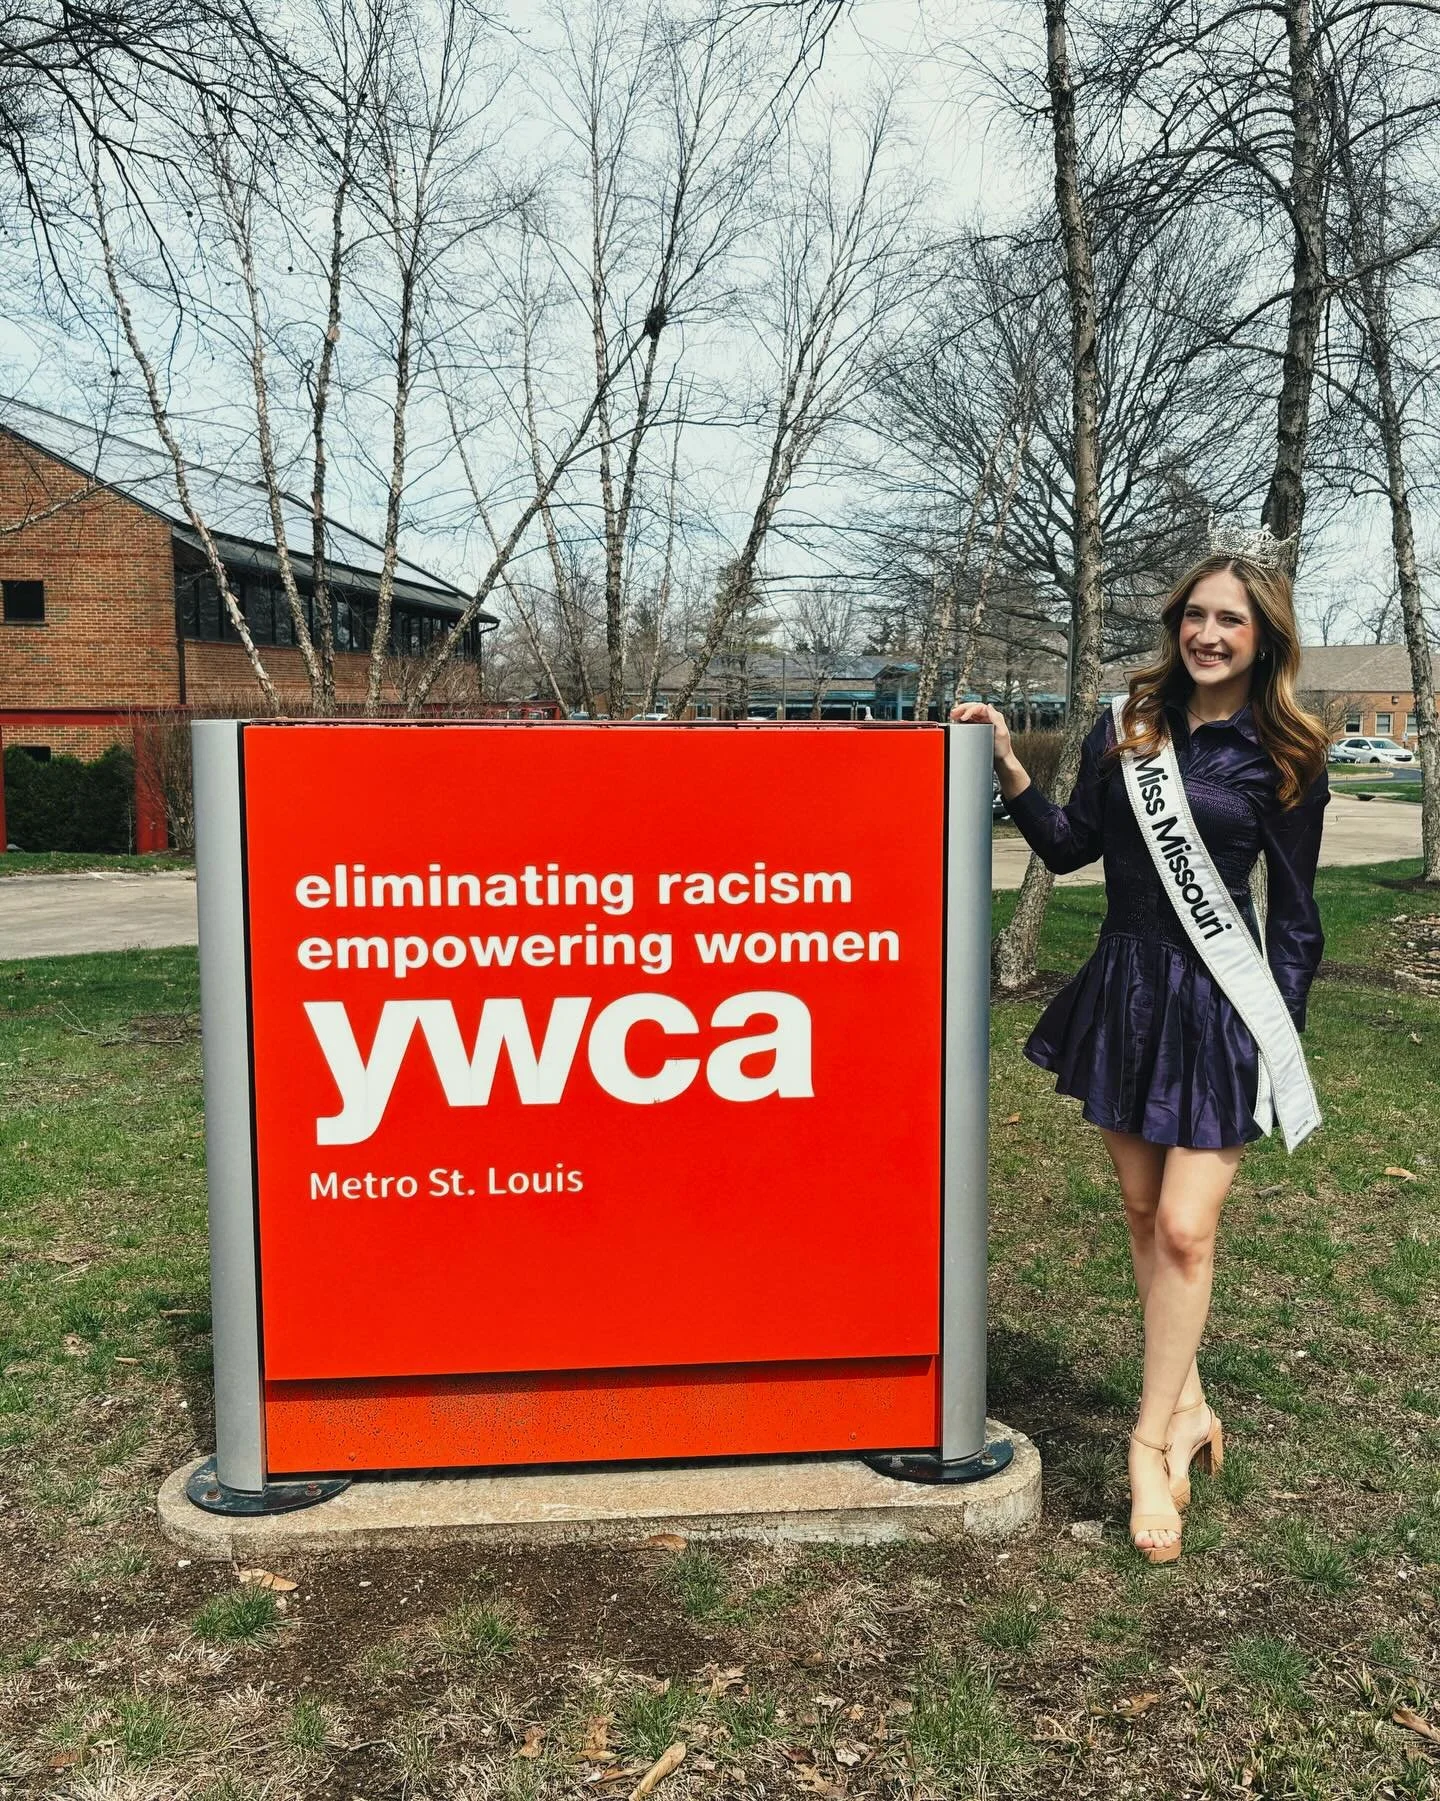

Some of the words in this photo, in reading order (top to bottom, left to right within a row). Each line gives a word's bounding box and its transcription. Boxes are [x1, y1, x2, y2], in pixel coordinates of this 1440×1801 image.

[1132, 751, 1169, 816] Miss
[1151, 815, 1232, 941] Missouri
[296, 863, 634, 915] eliminating
[658, 862, 853, 906] racism
[297, 923, 673, 978] empowering
[694, 930, 900, 964] women
[303, 990, 815, 1146] ywca
[310, 1171, 418, 1200] Metro
[428, 1168, 476, 1197] St.
[488, 1163, 584, 1195] Louis
